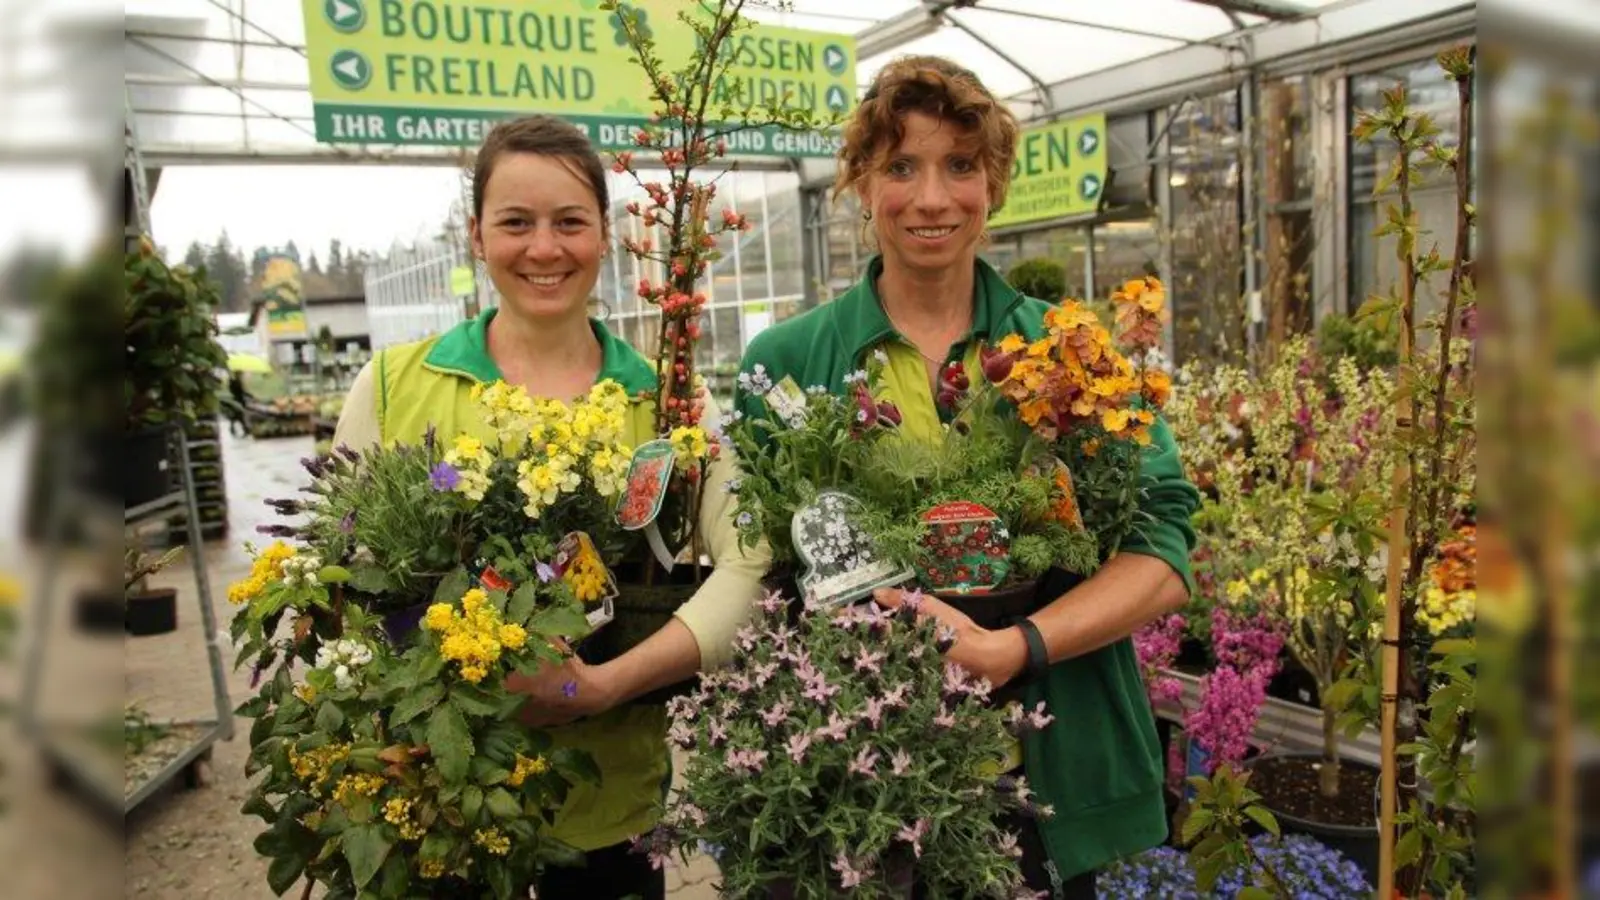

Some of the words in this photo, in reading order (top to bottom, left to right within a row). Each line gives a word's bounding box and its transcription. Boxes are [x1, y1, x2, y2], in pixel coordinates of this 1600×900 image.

[380, 0, 597, 53] BOUTIQUE
[386, 53, 595, 101] FREILAND
[331, 113, 386, 138] IHR
